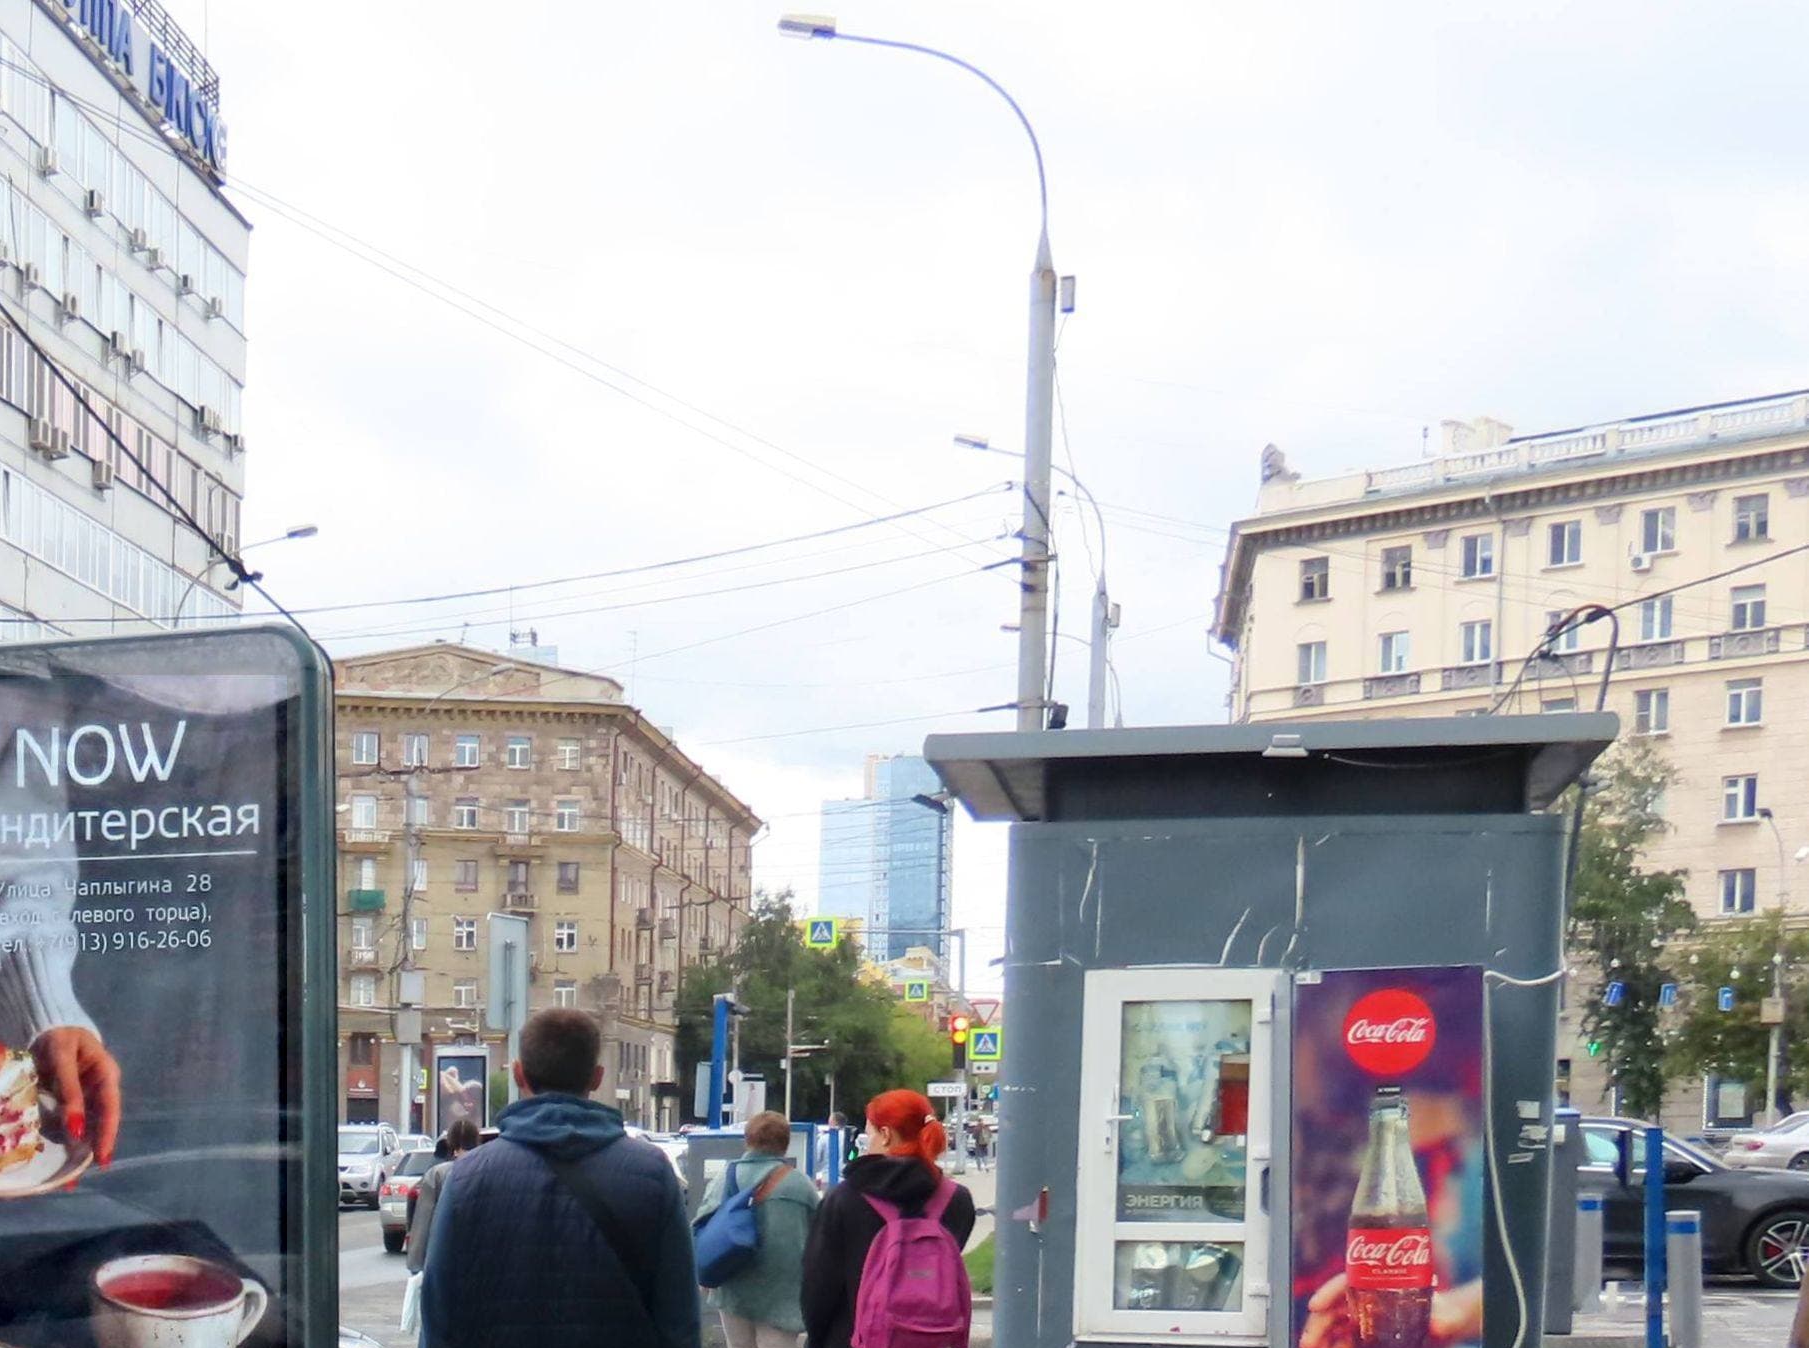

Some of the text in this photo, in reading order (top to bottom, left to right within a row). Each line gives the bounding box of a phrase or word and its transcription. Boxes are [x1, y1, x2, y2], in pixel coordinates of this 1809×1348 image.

[15, 720, 187, 788] NOW
[64, 879, 173, 896] Чаплыгина
[186, 873, 212, 892] 28
[71, 908, 135, 924] левого
[146, 902, 212, 925] торца),
[112, 929, 212, 950] 916-26-06
[1347, 1017, 1430, 1044] Coca-Cola
[1125, 1194, 1203, 1209] ЭНЕРГИЯ
[1347, 1235, 1430, 1266] Coca-Cola
